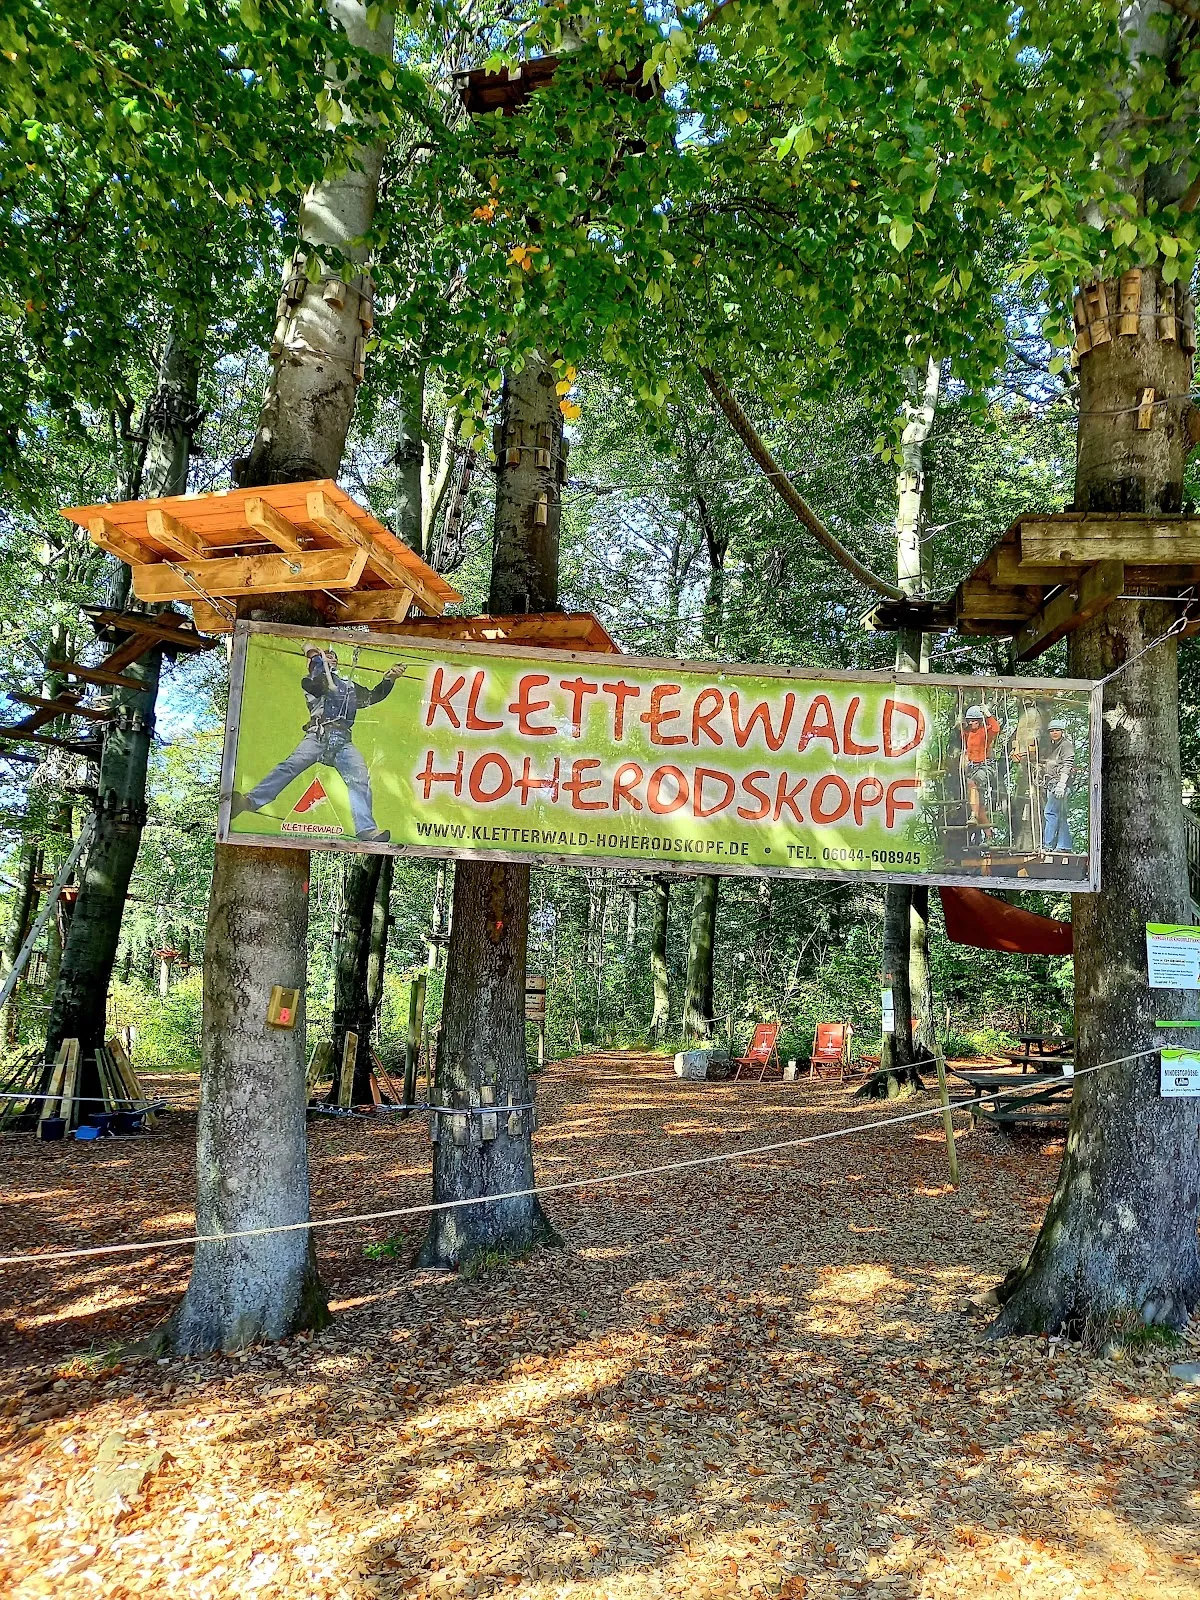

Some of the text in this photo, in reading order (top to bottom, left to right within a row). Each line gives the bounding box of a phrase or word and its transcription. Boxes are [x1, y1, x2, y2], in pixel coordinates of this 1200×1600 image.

[426, 667, 926, 758] KLETTERWALD
[416, 750, 922, 828] HOHERODSKOPF
[281, 823, 343, 834] KLETTERWALD
[416, 822, 921, 865] WWW.KLETTERWALD-HOHERODSKOPF.DE TEL. 06044-608945
